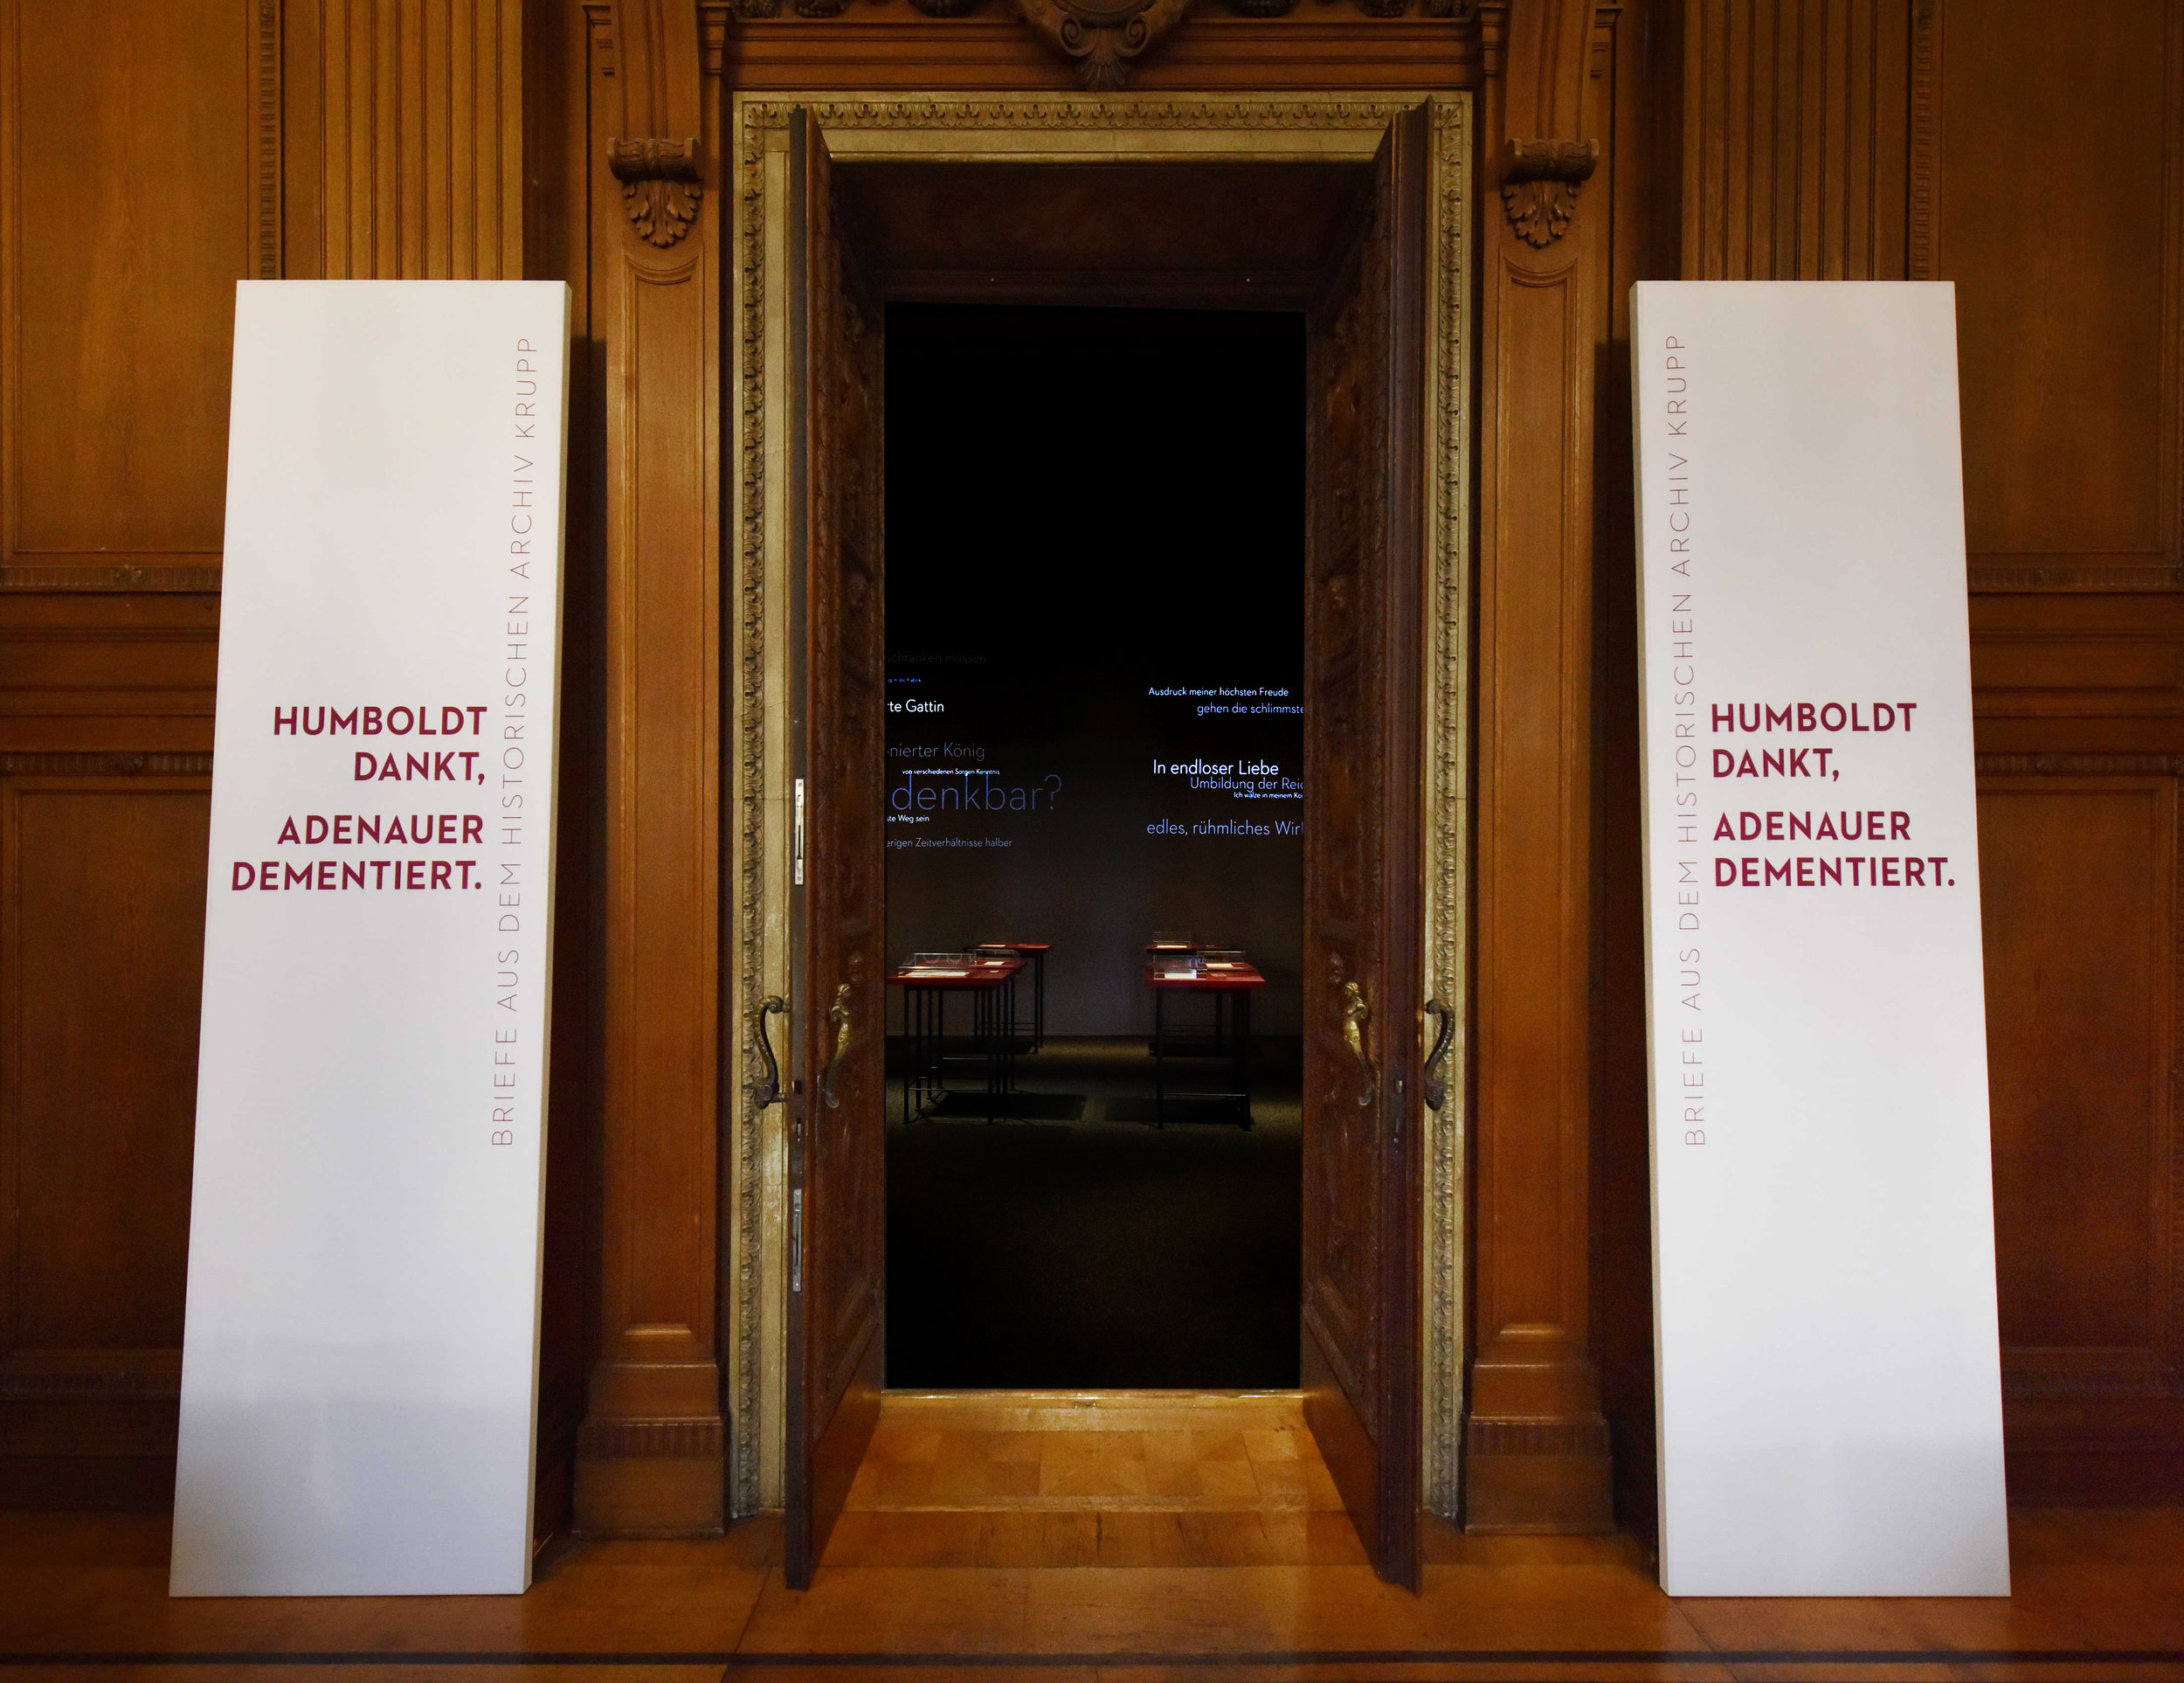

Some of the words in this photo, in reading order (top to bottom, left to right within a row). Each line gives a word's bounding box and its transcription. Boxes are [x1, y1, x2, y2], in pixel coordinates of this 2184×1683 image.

[516, 337, 538, 439] KRUPP
[1665, 335, 1688, 436] KRUPP
[510, 454, 535, 579] ARCHIV
[1668, 453, 1690, 577] ARCHIV
[888, 701, 902, 712] te
[905, 698, 944, 713] Gattin
[1149, 687, 1186, 696] Ausdruck
[1189, 688, 1217, 696] meiner
[1219, 687, 1257, 696] höchsten
[1259, 687, 1289, 696] Freude
[274, 705, 487, 736] HUMBOLDT
[501, 596, 529, 845] HISTORISCHEN
[1197, 702, 1229, 717] gehen
[1232, 702, 1248, 714] die
[1672, 592, 1697, 843] HISTORISCHEN
[1711, 702, 1918, 733] HUMBOLDT
[888, 743, 939, 758] nierter
[943, 742, 985, 762] König
[1153, 758, 1166, 775] In
[1171, 758, 1234, 775] endloser
[1239, 758, 1279, 775] Liebe
[1712, 747, 1839, 782] DANKT,
[354, 751, 486, 786] DANKT,
[955, 768, 975, 777] Sorgen
[892, 771, 1061, 811] denkbar?
[1190, 777, 1254, 793] Umbildung
[1258, 777, 1278, 790] der
[277, 814, 483, 845] ADENAUER
[898, 814, 914, 824] Weg
[1146, 819, 1188, 836] edles,
[1192, 819, 1270, 835] rühmliches
[1713, 810, 1911, 842] ADENAUER
[916, 837, 983, 848] Zeitverhältnisse
[985, 837, 1013, 848] halber
[232, 860, 482, 891] DEMENTIERT.
[1714, 856, 1954, 887] DEMENTIERT.
[499, 862, 522, 932] DEM
[1678, 861, 1700, 932] DEM
[496, 950, 519, 1011] AUS
[1680, 947, 1702, 1010] AUS
[492, 1029, 517, 1146] BRIEFE
[1683, 1028, 1706, 1146] BRIEFE
